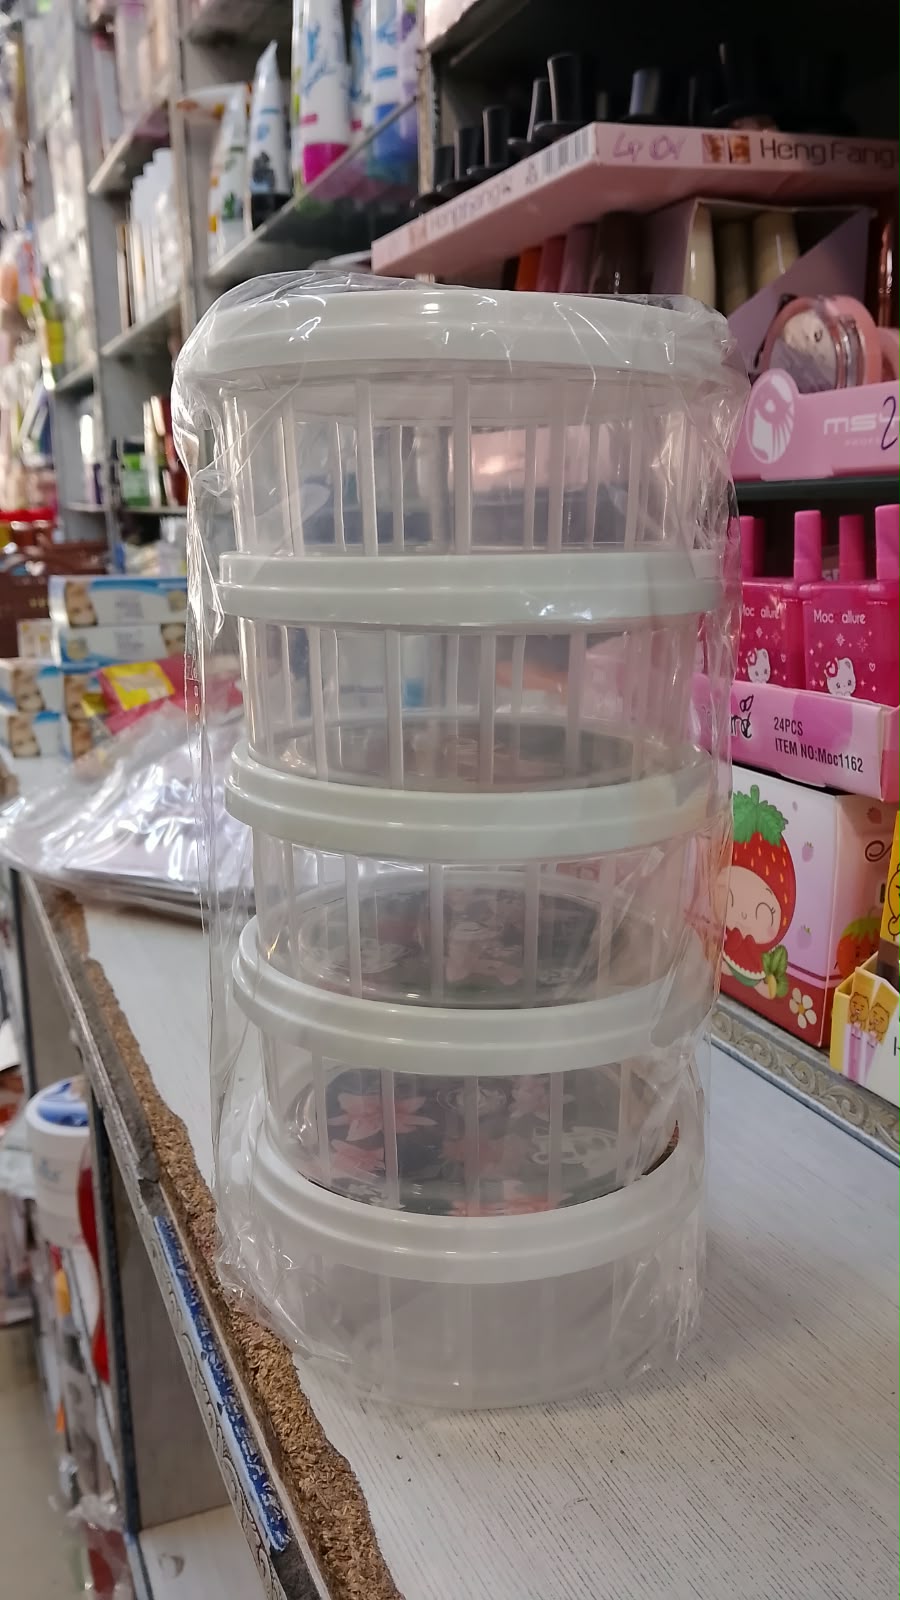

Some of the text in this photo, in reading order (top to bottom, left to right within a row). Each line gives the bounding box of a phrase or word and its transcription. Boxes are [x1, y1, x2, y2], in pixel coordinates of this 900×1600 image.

[813, 609, 866, 625] Moc allure
[774, 717, 804, 737] 24PCS
[775, 738, 864, 773] ITEM NO:Moc1162
